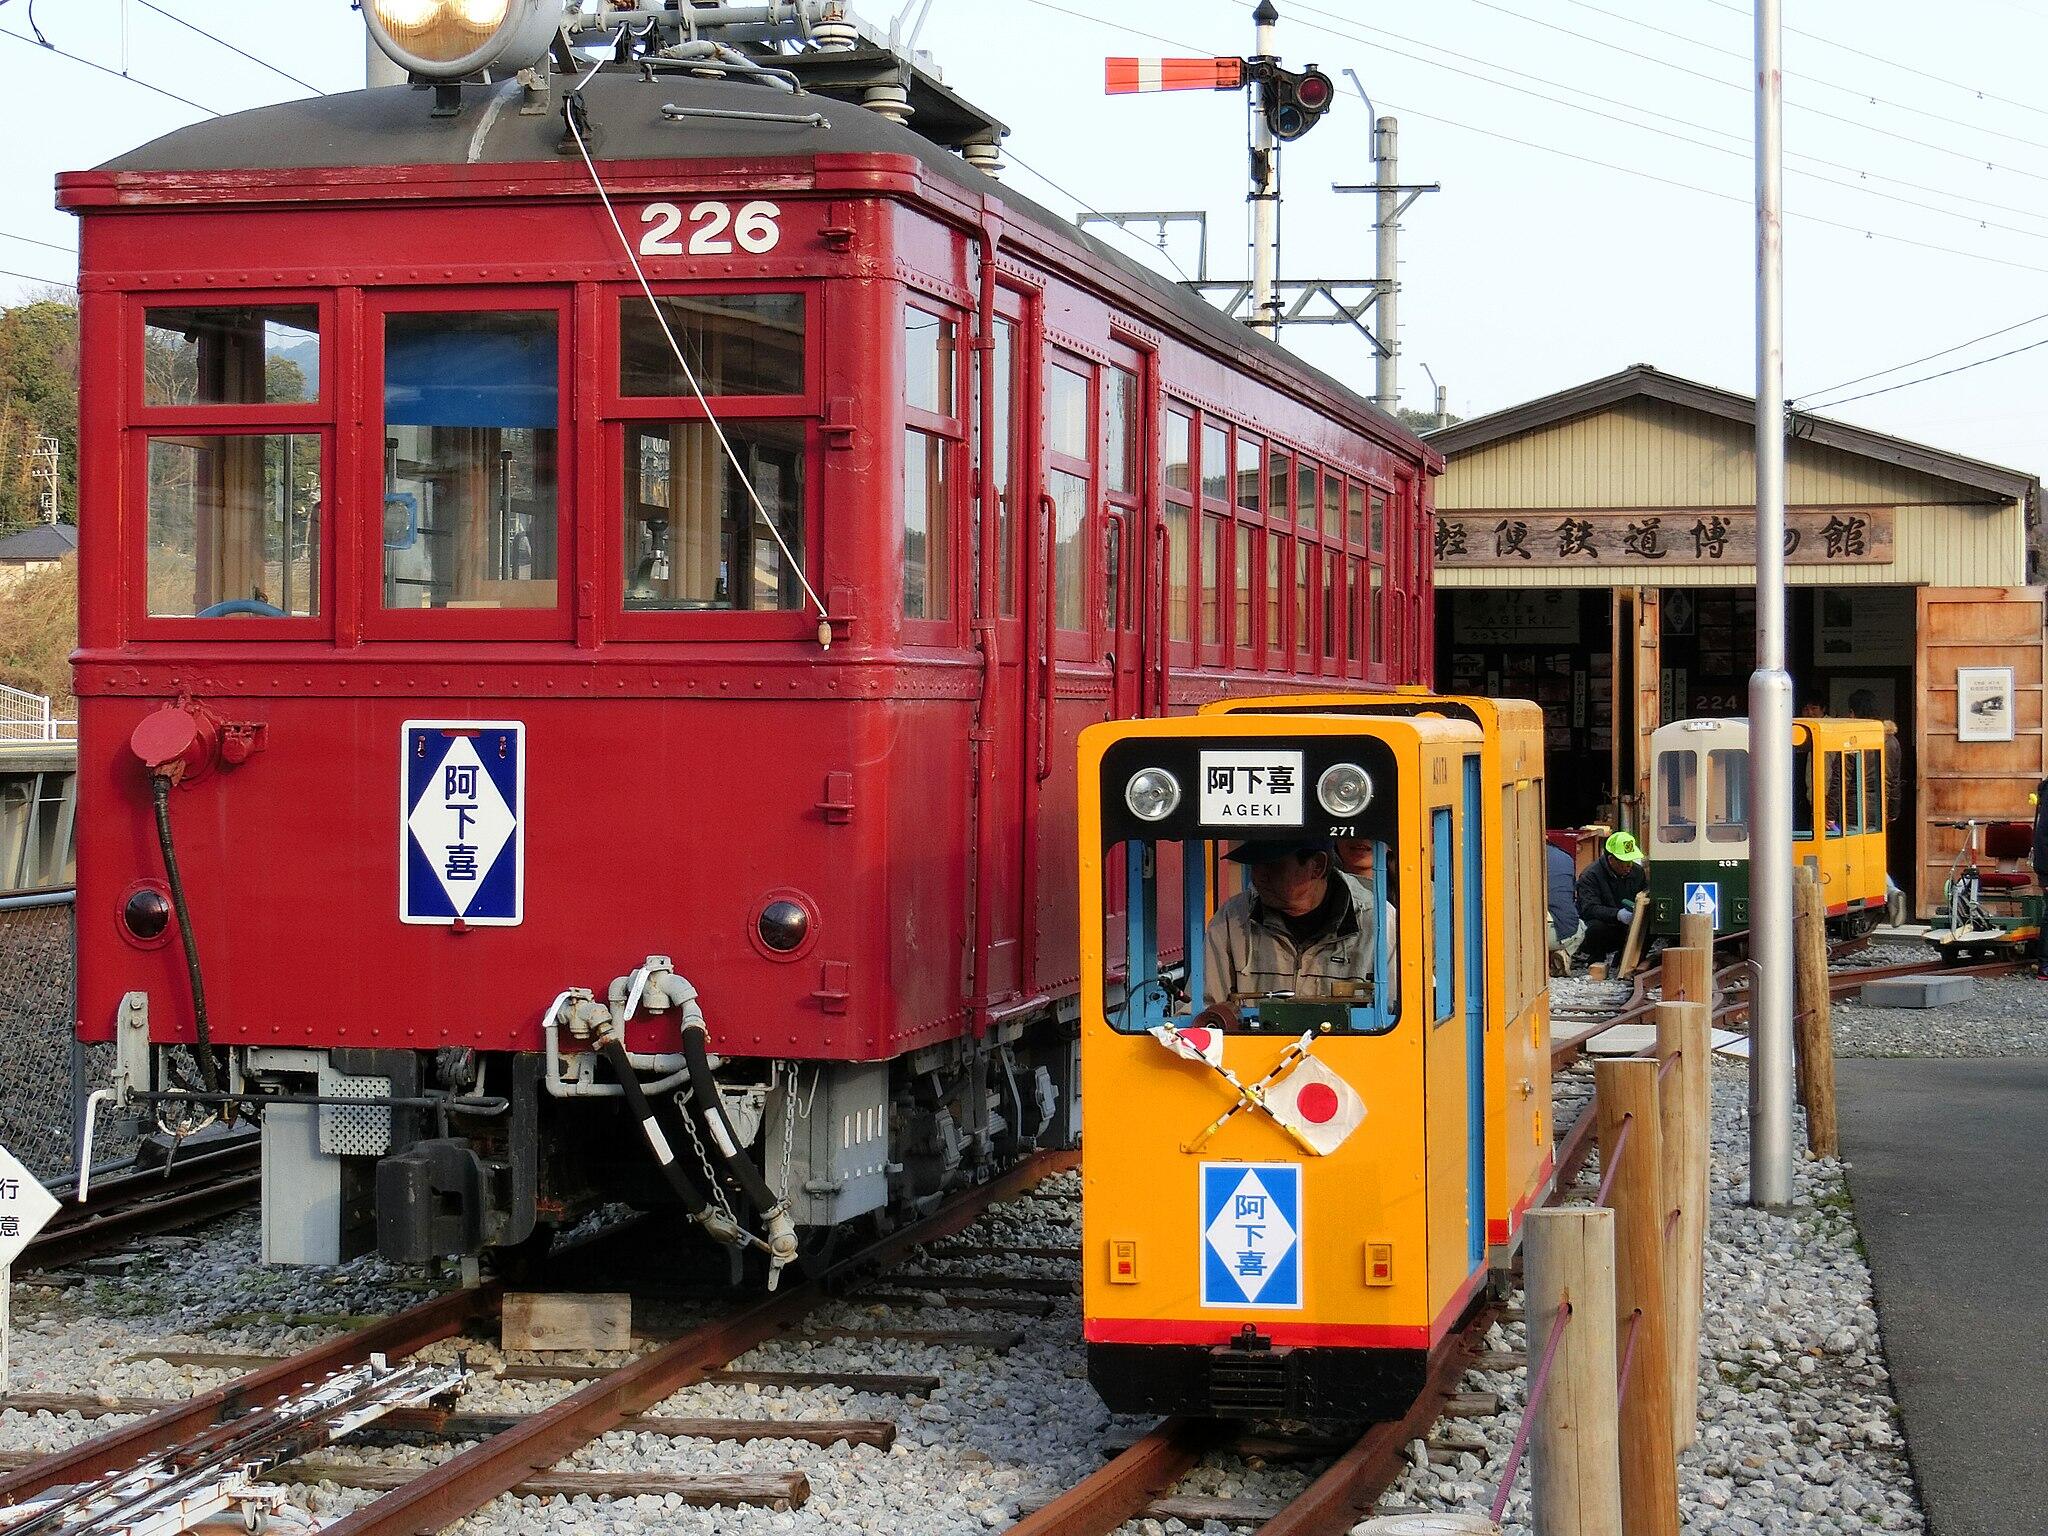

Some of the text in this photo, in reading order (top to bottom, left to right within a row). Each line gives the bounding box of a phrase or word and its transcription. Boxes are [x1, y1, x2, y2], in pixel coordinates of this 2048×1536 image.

[640, 201, 781, 256] 226
[1695, 695, 1738, 710] 224
[1206, 765, 1295, 795] 阿下喜
[1222, 803, 1282, 817] AGEKI
[444, 764, 480, 882] 阿下喜
[1329, 826, 1356, 837] 271
[0, 1178, 19, 1200] 行
[0, 1215, 20, 1237] 意
[1234, 1194, 1268, 1277] 阿下喜
